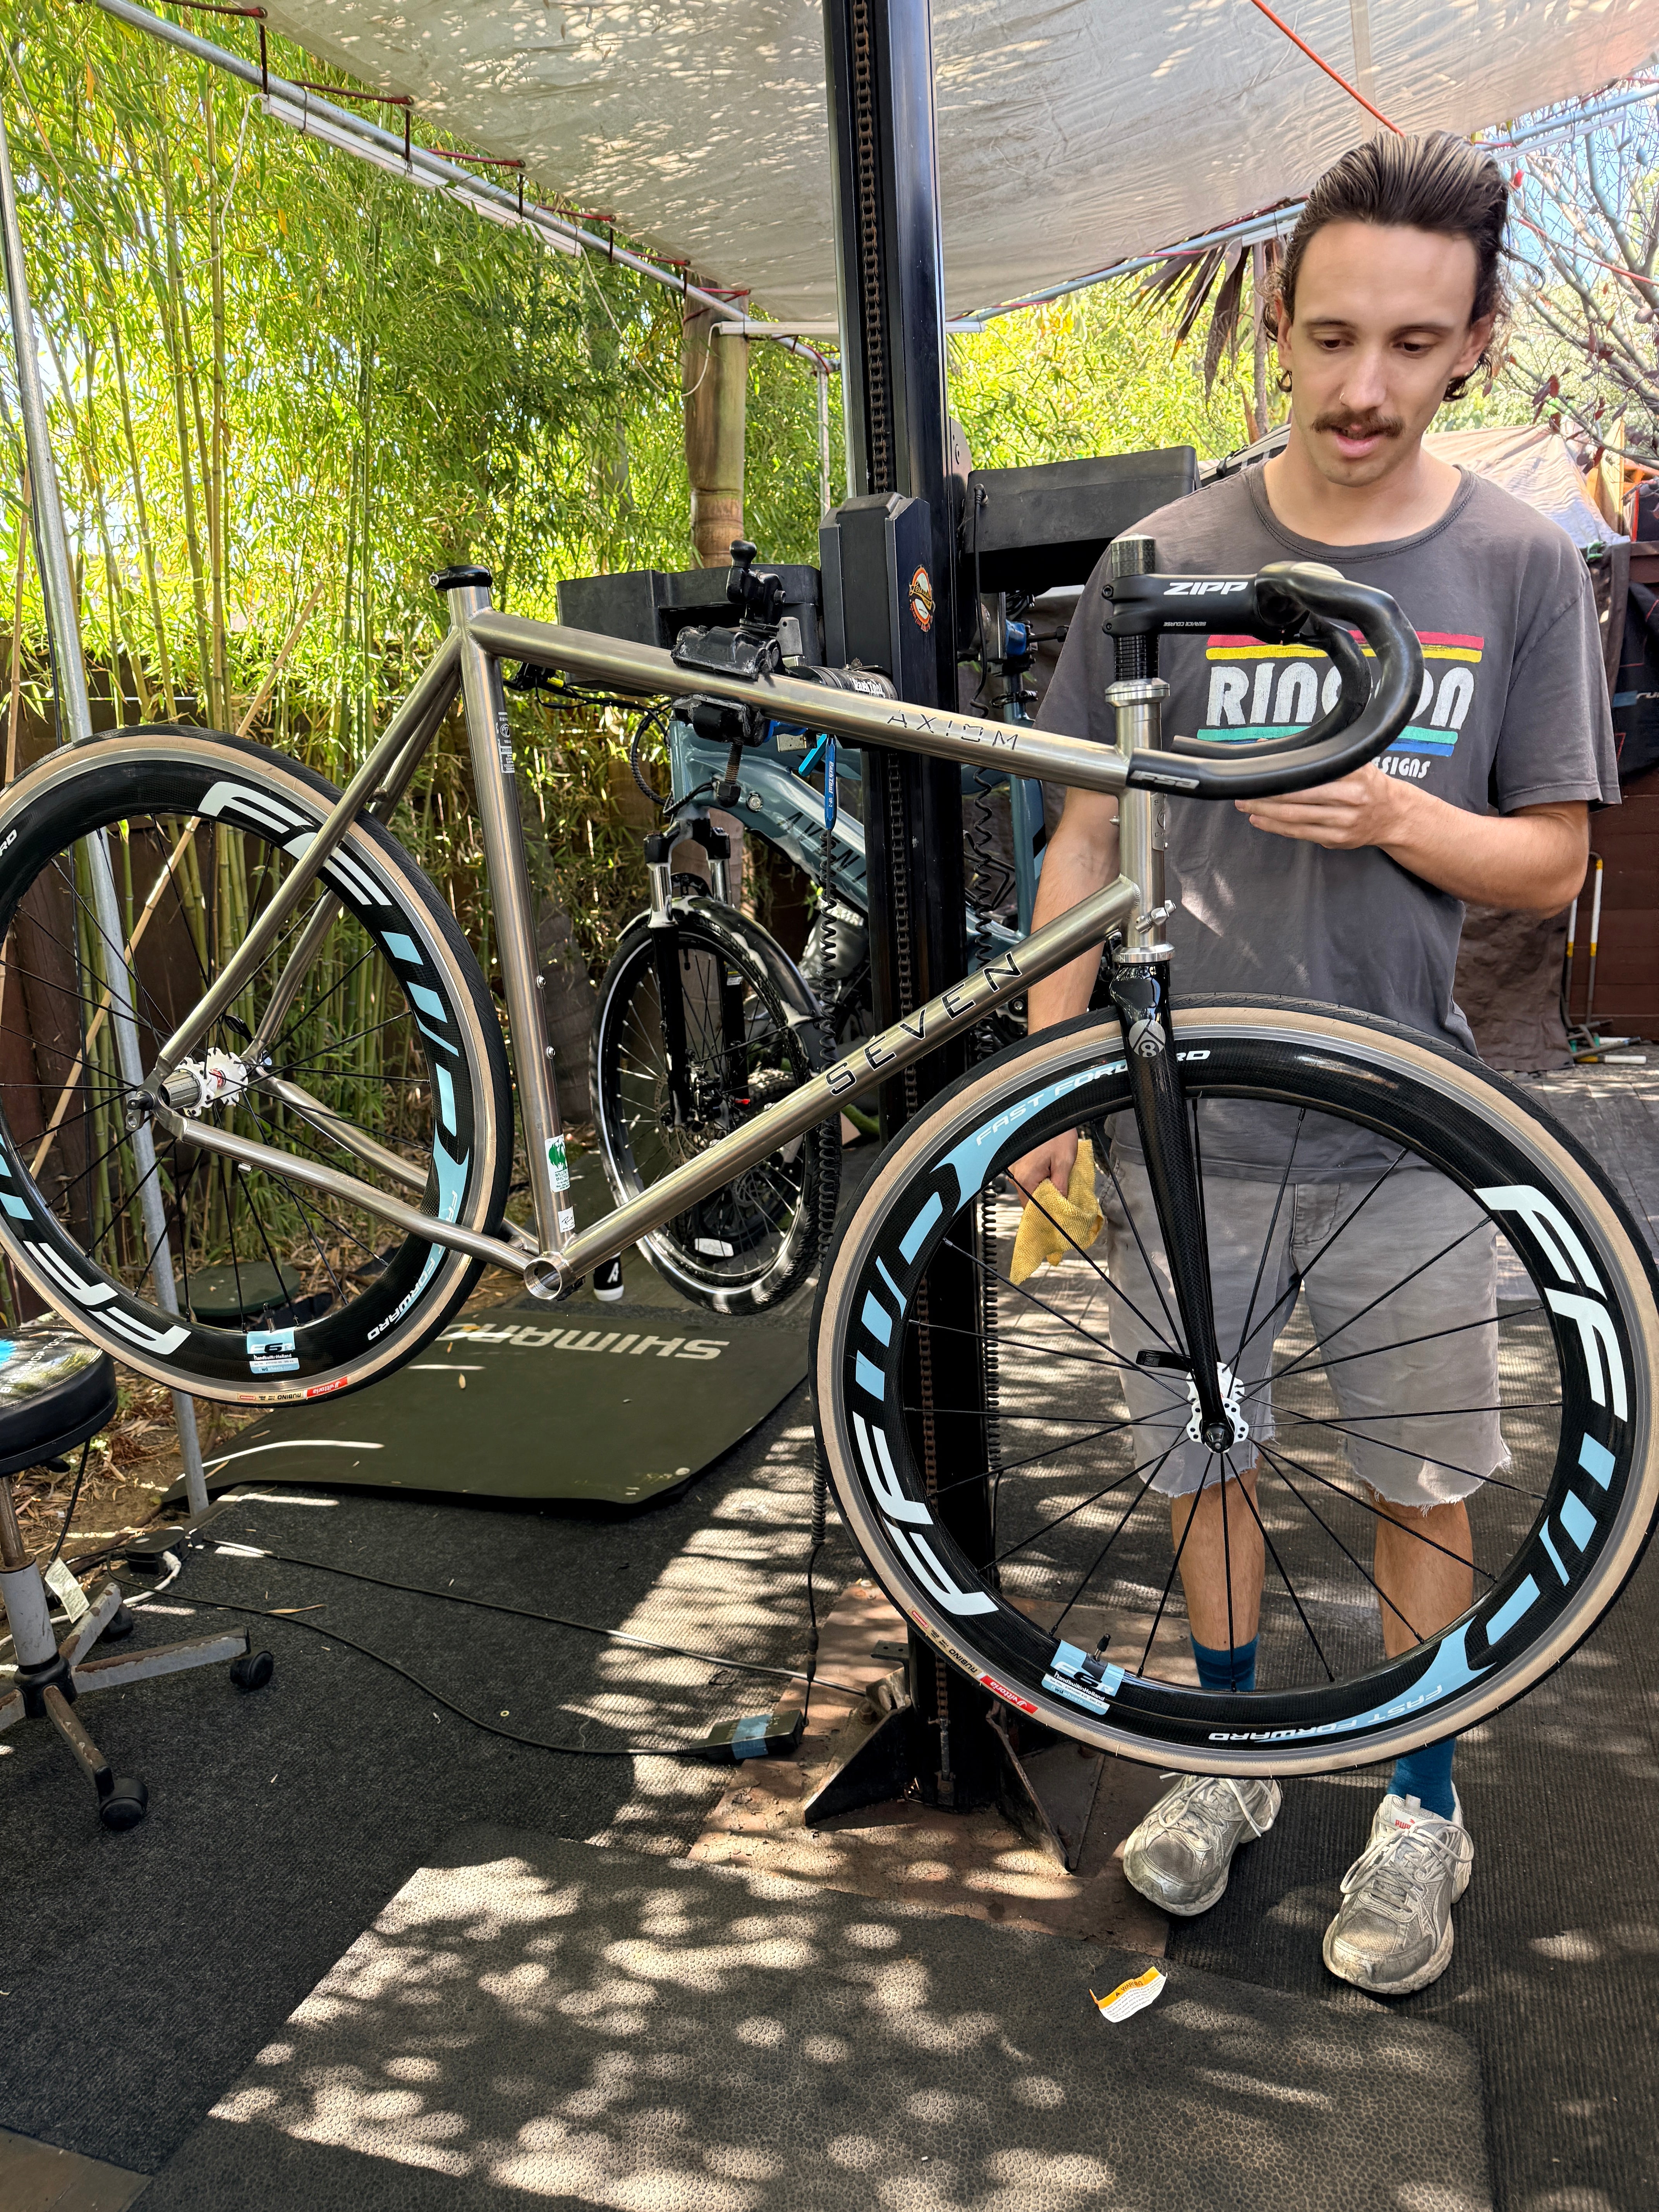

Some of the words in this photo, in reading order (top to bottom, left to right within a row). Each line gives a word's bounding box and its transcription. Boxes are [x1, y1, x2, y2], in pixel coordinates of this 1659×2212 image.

[1163, 582, 1248, 595] ZIPP
[825, 951, 1022, 1096] SEVEN
[976, 1093, 1044, 1146] FAST
[367, 1257, 435, 1341] FORWARD
[434, 1323, 730, 1360] SHIMANO
[0, 1373, 24, 1393] BIKE
[19, 1351, 45, 1371] SHOP
[43, 1331, 74, 1350] TOOLS
[313, 1381, 342, 1394] vittoria
[949, 1648, 978, 1673] RUBINO
[990, 1681, 1027, 1707] vittoria
[1054, 1671, 1105, 1701] handbuiltinHolland
[1368, 1685, 1443, 1723] FAST
[1208, 1719, 1357, 1741] FORWARD
